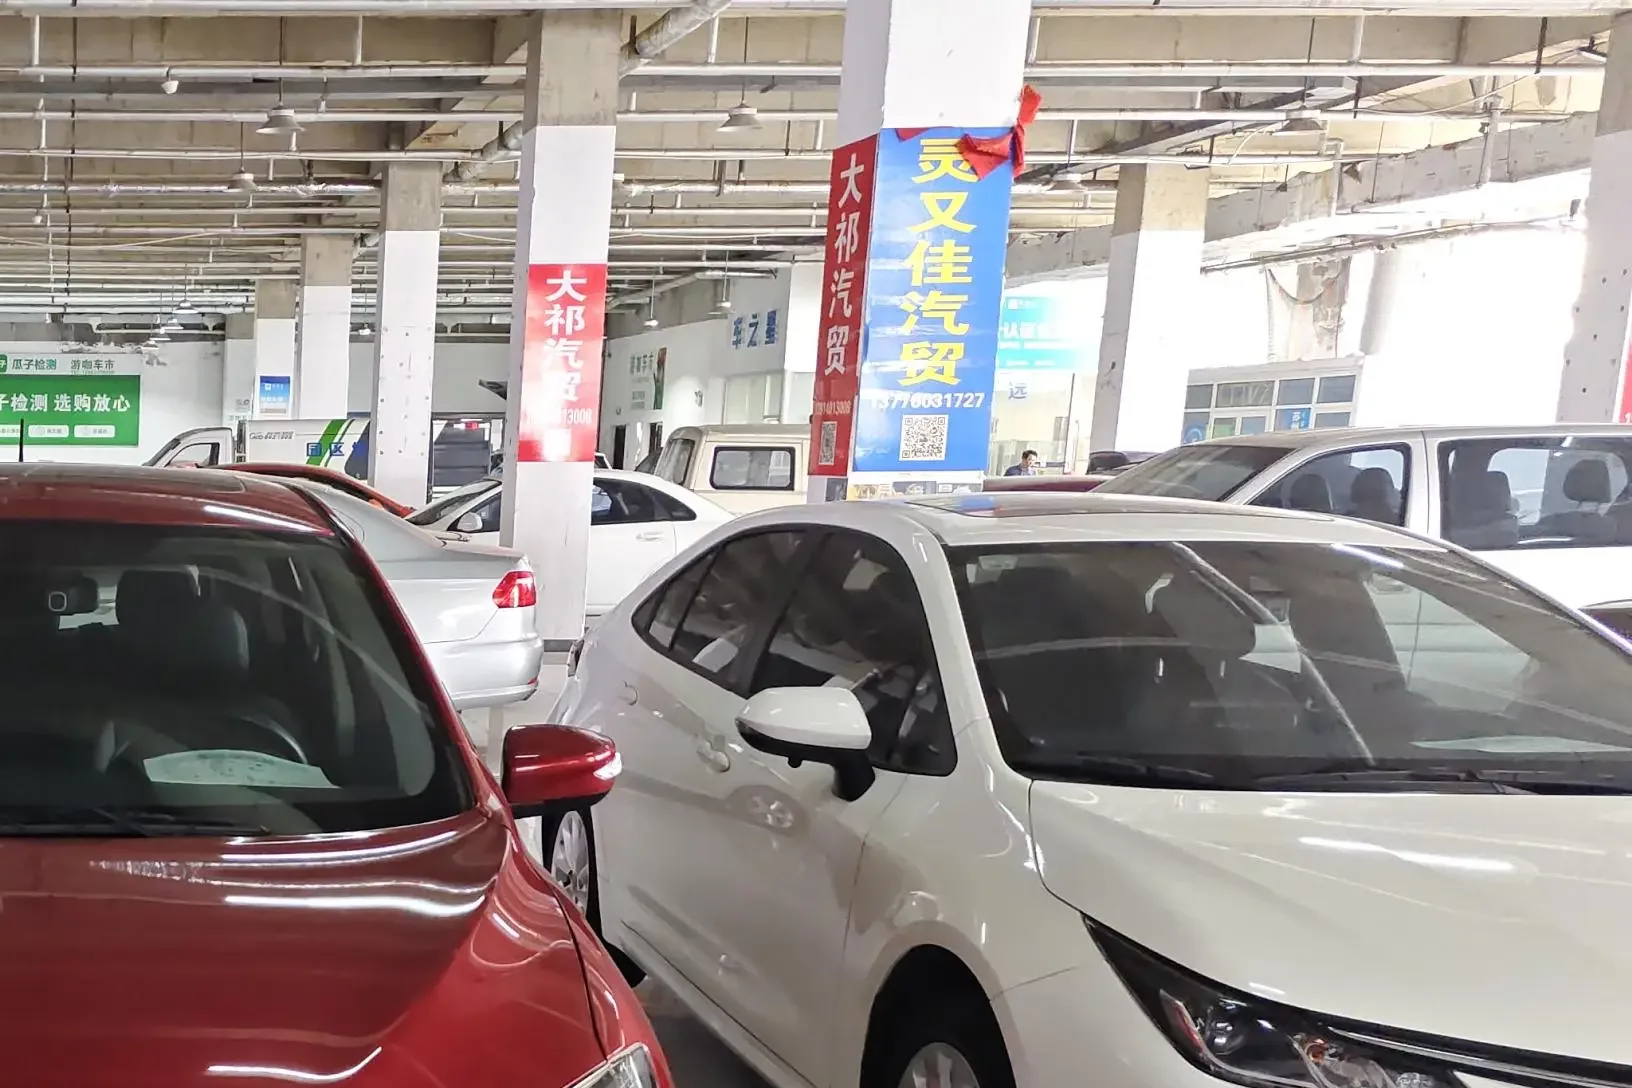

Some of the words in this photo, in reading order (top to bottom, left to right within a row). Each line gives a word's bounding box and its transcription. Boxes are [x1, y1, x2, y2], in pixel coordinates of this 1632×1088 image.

[824, 152, 865, 376] 大祁汽贸
[897, 138, 978, 386] 灵又佳汽贸
[12, 358, 57, 371] 瓜子检测
[54, 392, 131, 412] 选购放心
